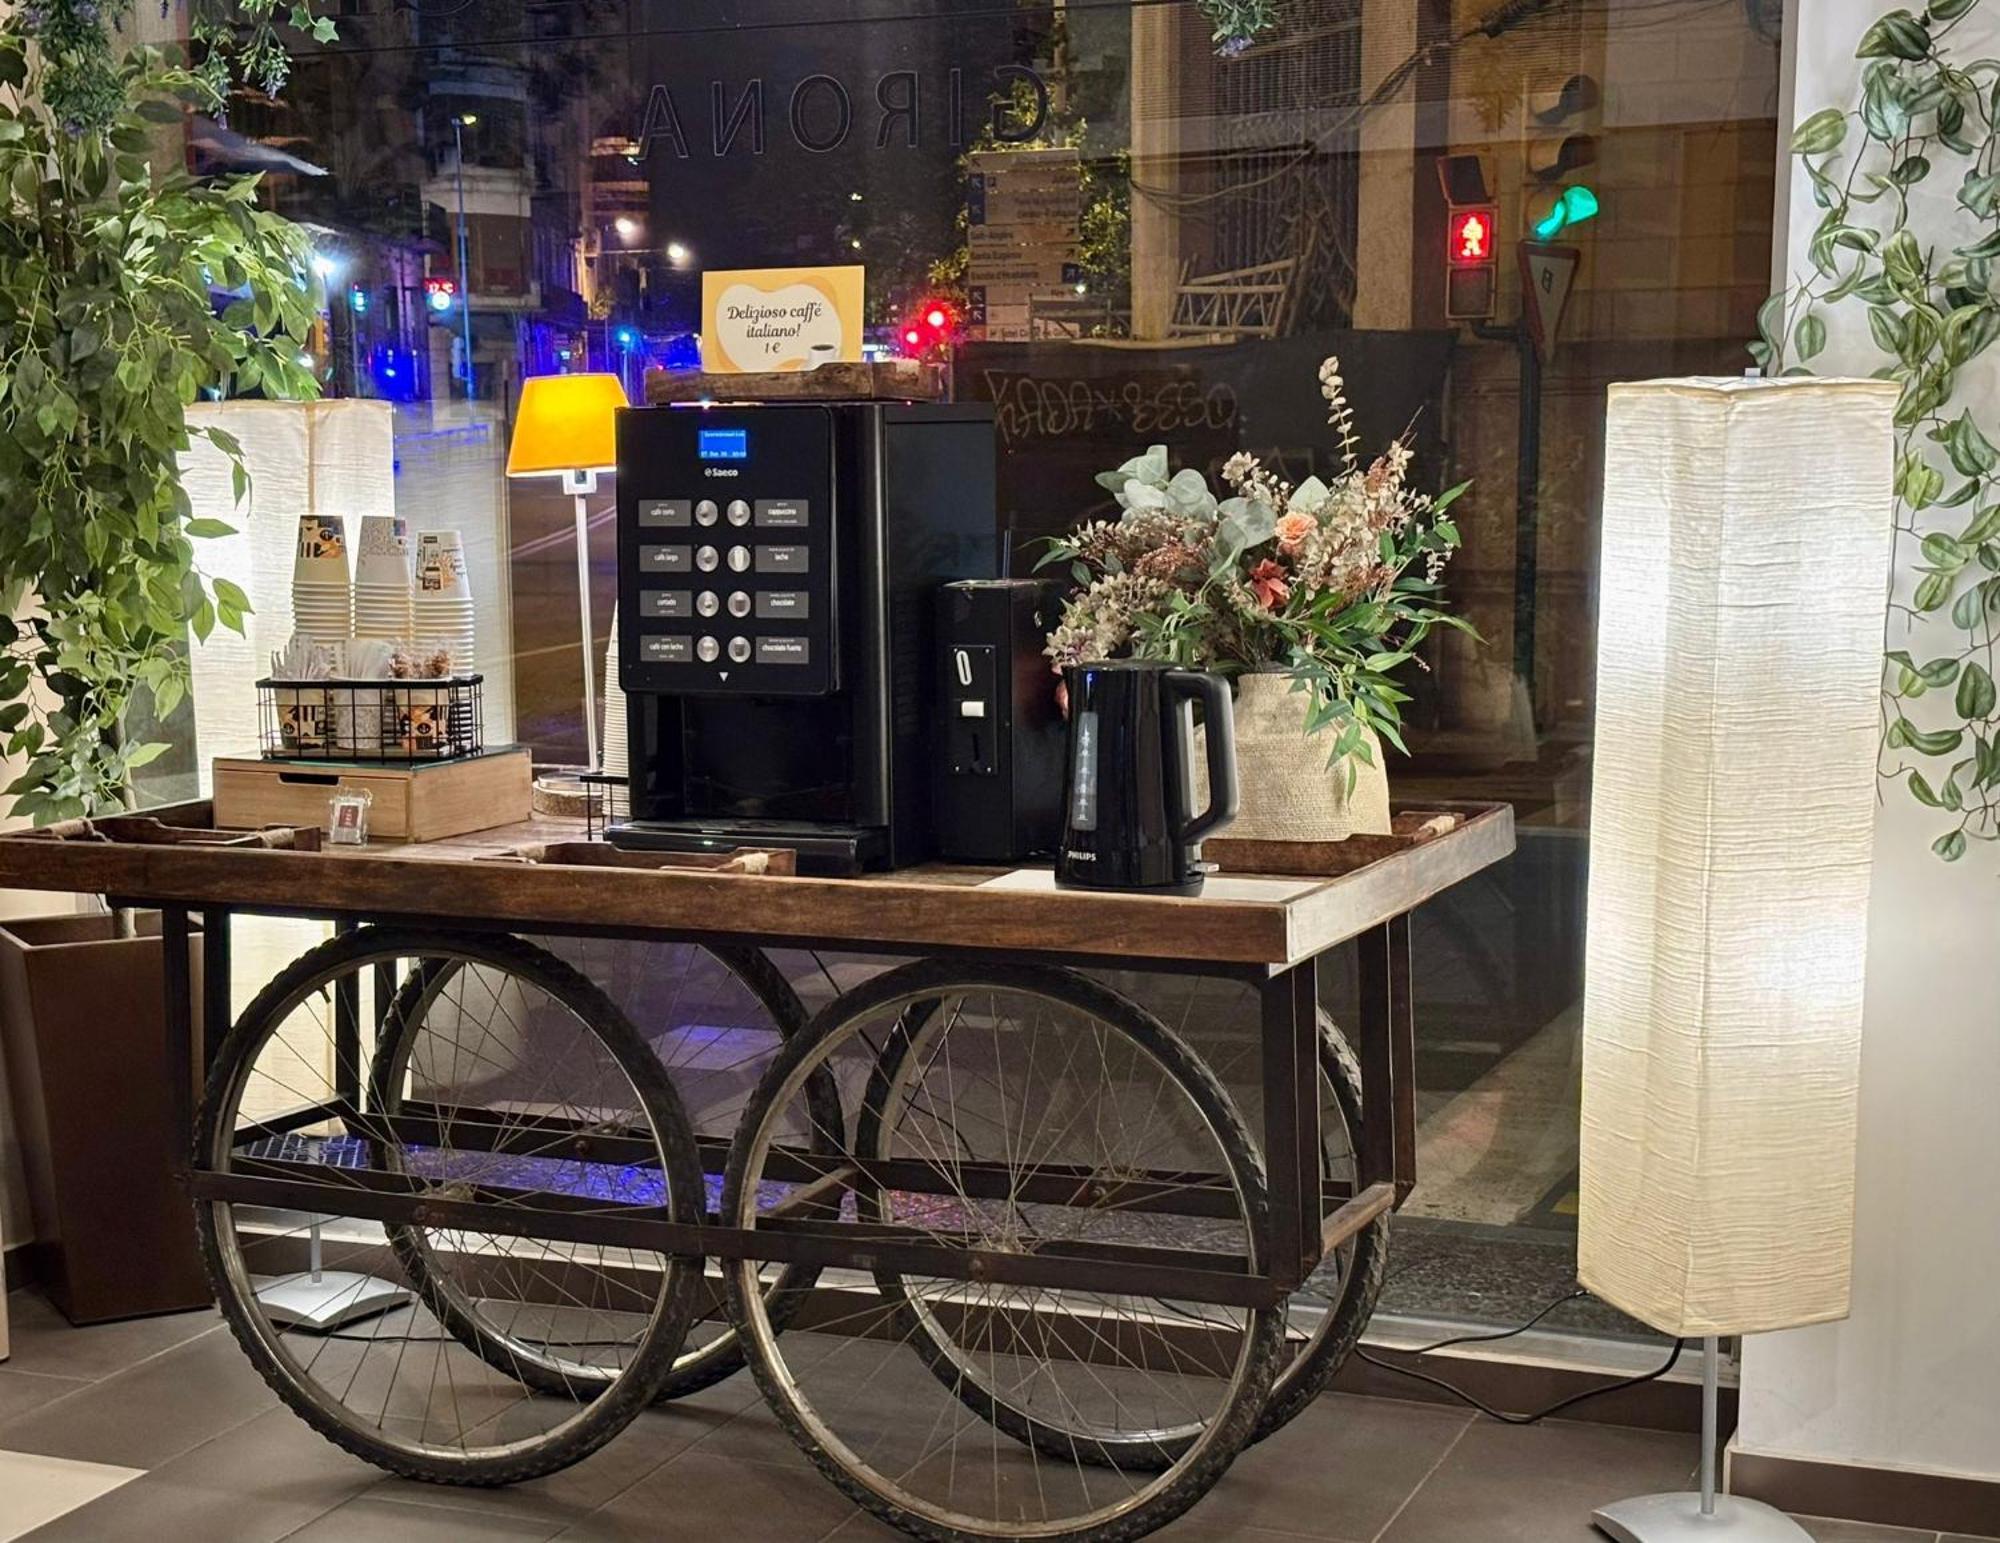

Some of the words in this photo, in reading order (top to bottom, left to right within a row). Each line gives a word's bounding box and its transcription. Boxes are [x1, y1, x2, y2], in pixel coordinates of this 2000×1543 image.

[727, 304, 788, 325] Delizioso
[746, 322, 801, 339] italiano!
[764, 342, 770, 354] 1
[712, 467, 739, 477] Saeco
[1067, 850, 1097, 862] PHILIPS
